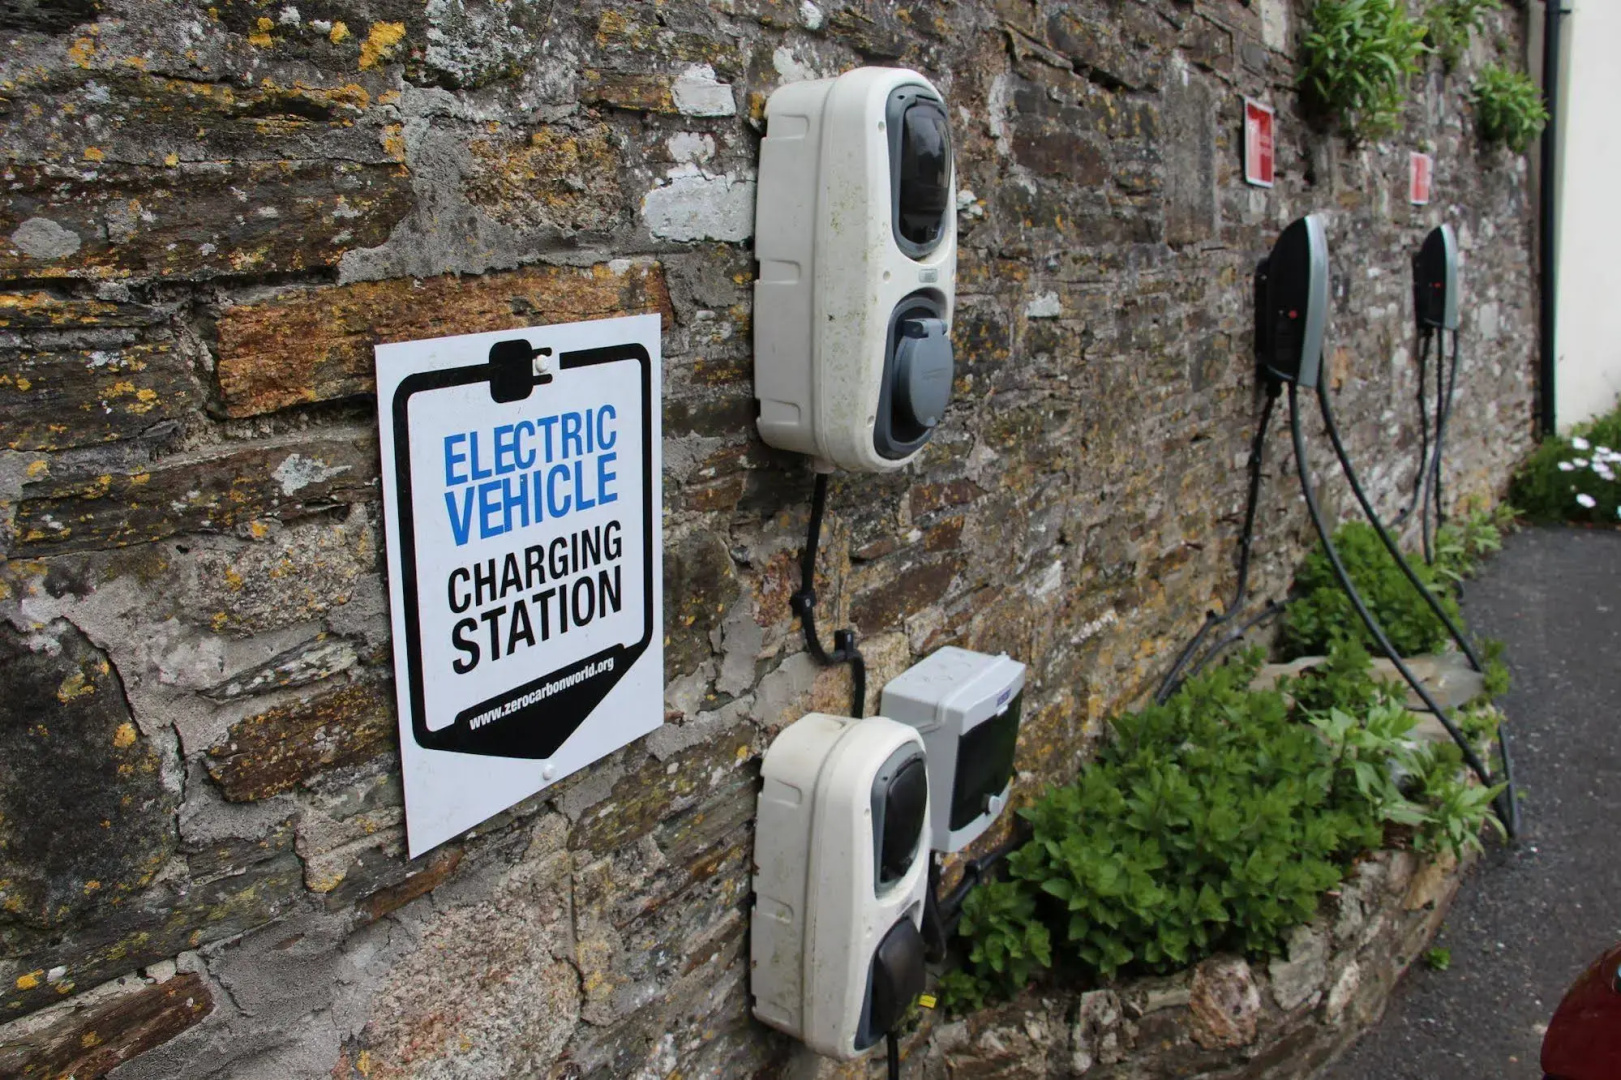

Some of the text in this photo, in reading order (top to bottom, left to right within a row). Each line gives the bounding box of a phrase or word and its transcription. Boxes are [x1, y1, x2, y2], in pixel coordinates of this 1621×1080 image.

[444, 404, 617, 487] ELECTRIC
[444, 452, 618, 547] VEHICLE
[448, 520, 622, 614] CHARGING
[452, 566, 622, 675] STATION
[469, 657, 615, 730] www.zerocarbonworld.org
